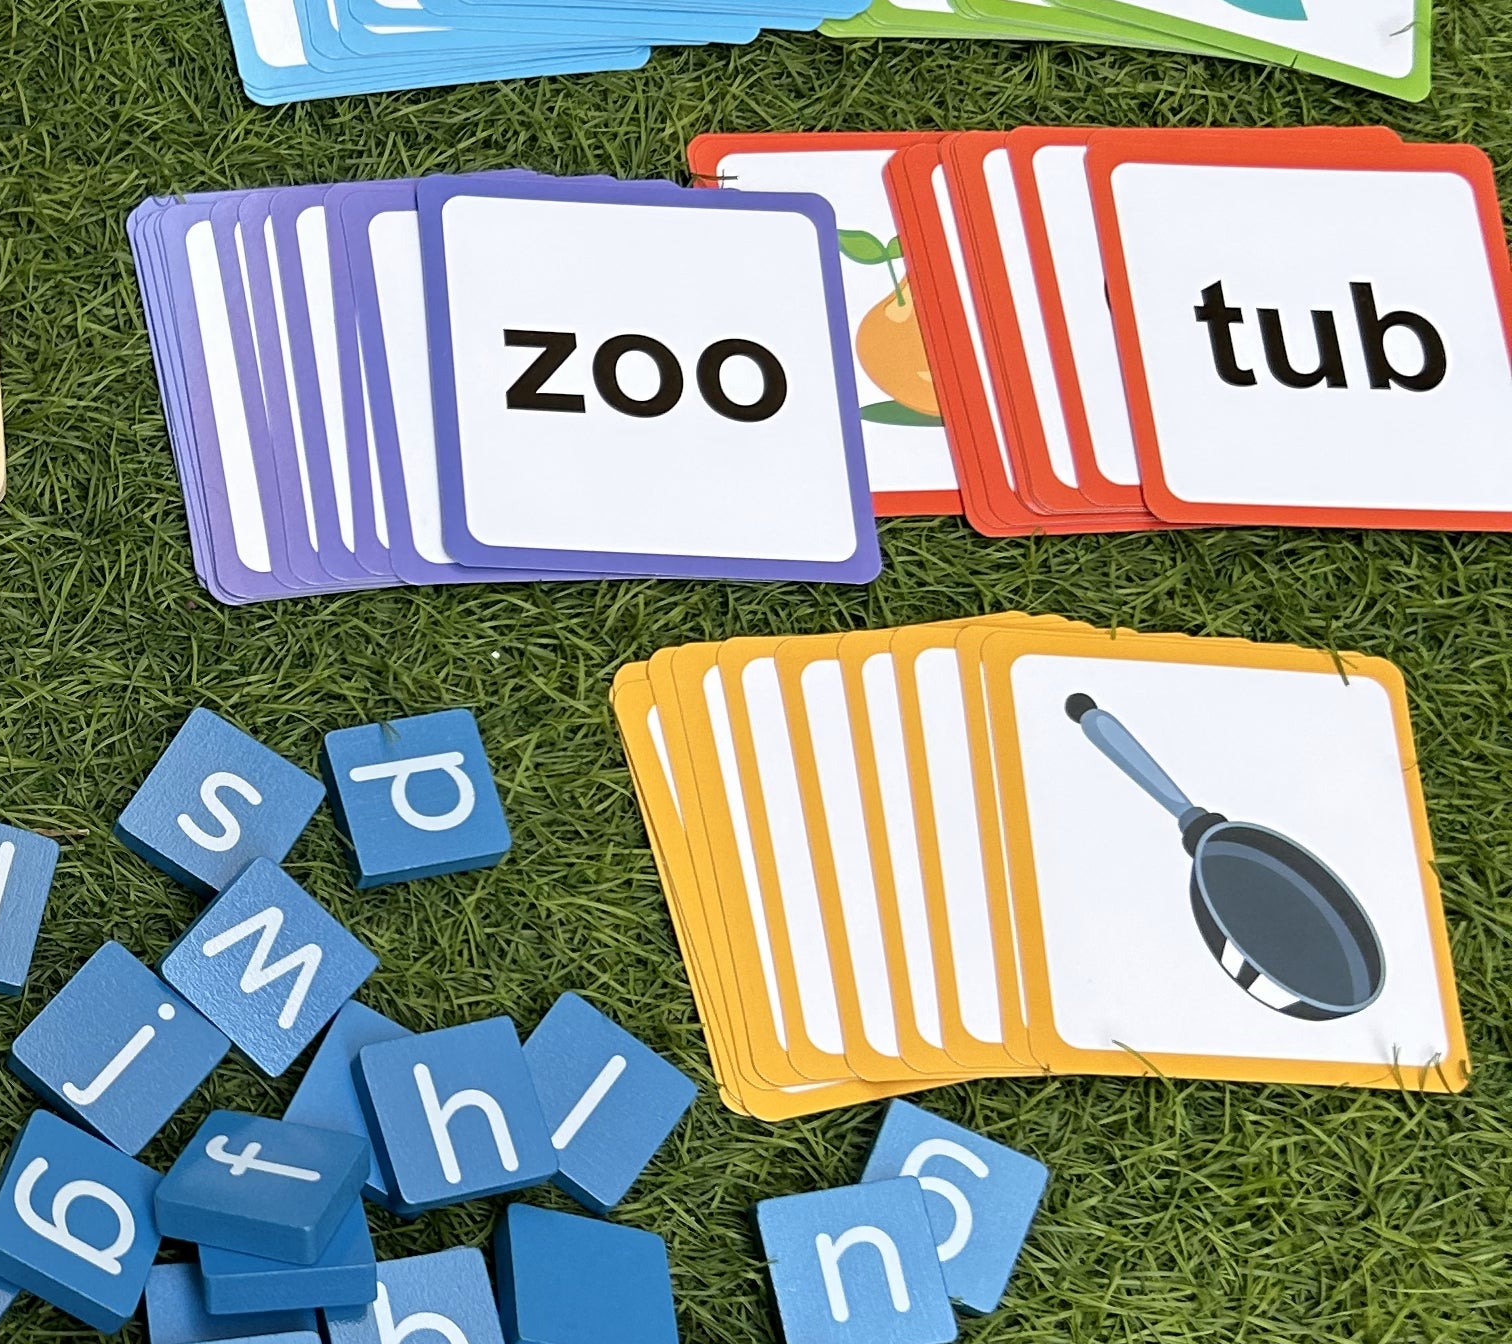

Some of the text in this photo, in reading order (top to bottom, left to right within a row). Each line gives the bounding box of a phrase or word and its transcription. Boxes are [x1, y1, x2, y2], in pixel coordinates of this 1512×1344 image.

[503, 329, 789, 423] zoo
[1194, 280, 1448, 392] tub
[177, 771, 262, 852] s
[62, 1002, 176, 1106] j
[413, 1063, 519, 1184] h
